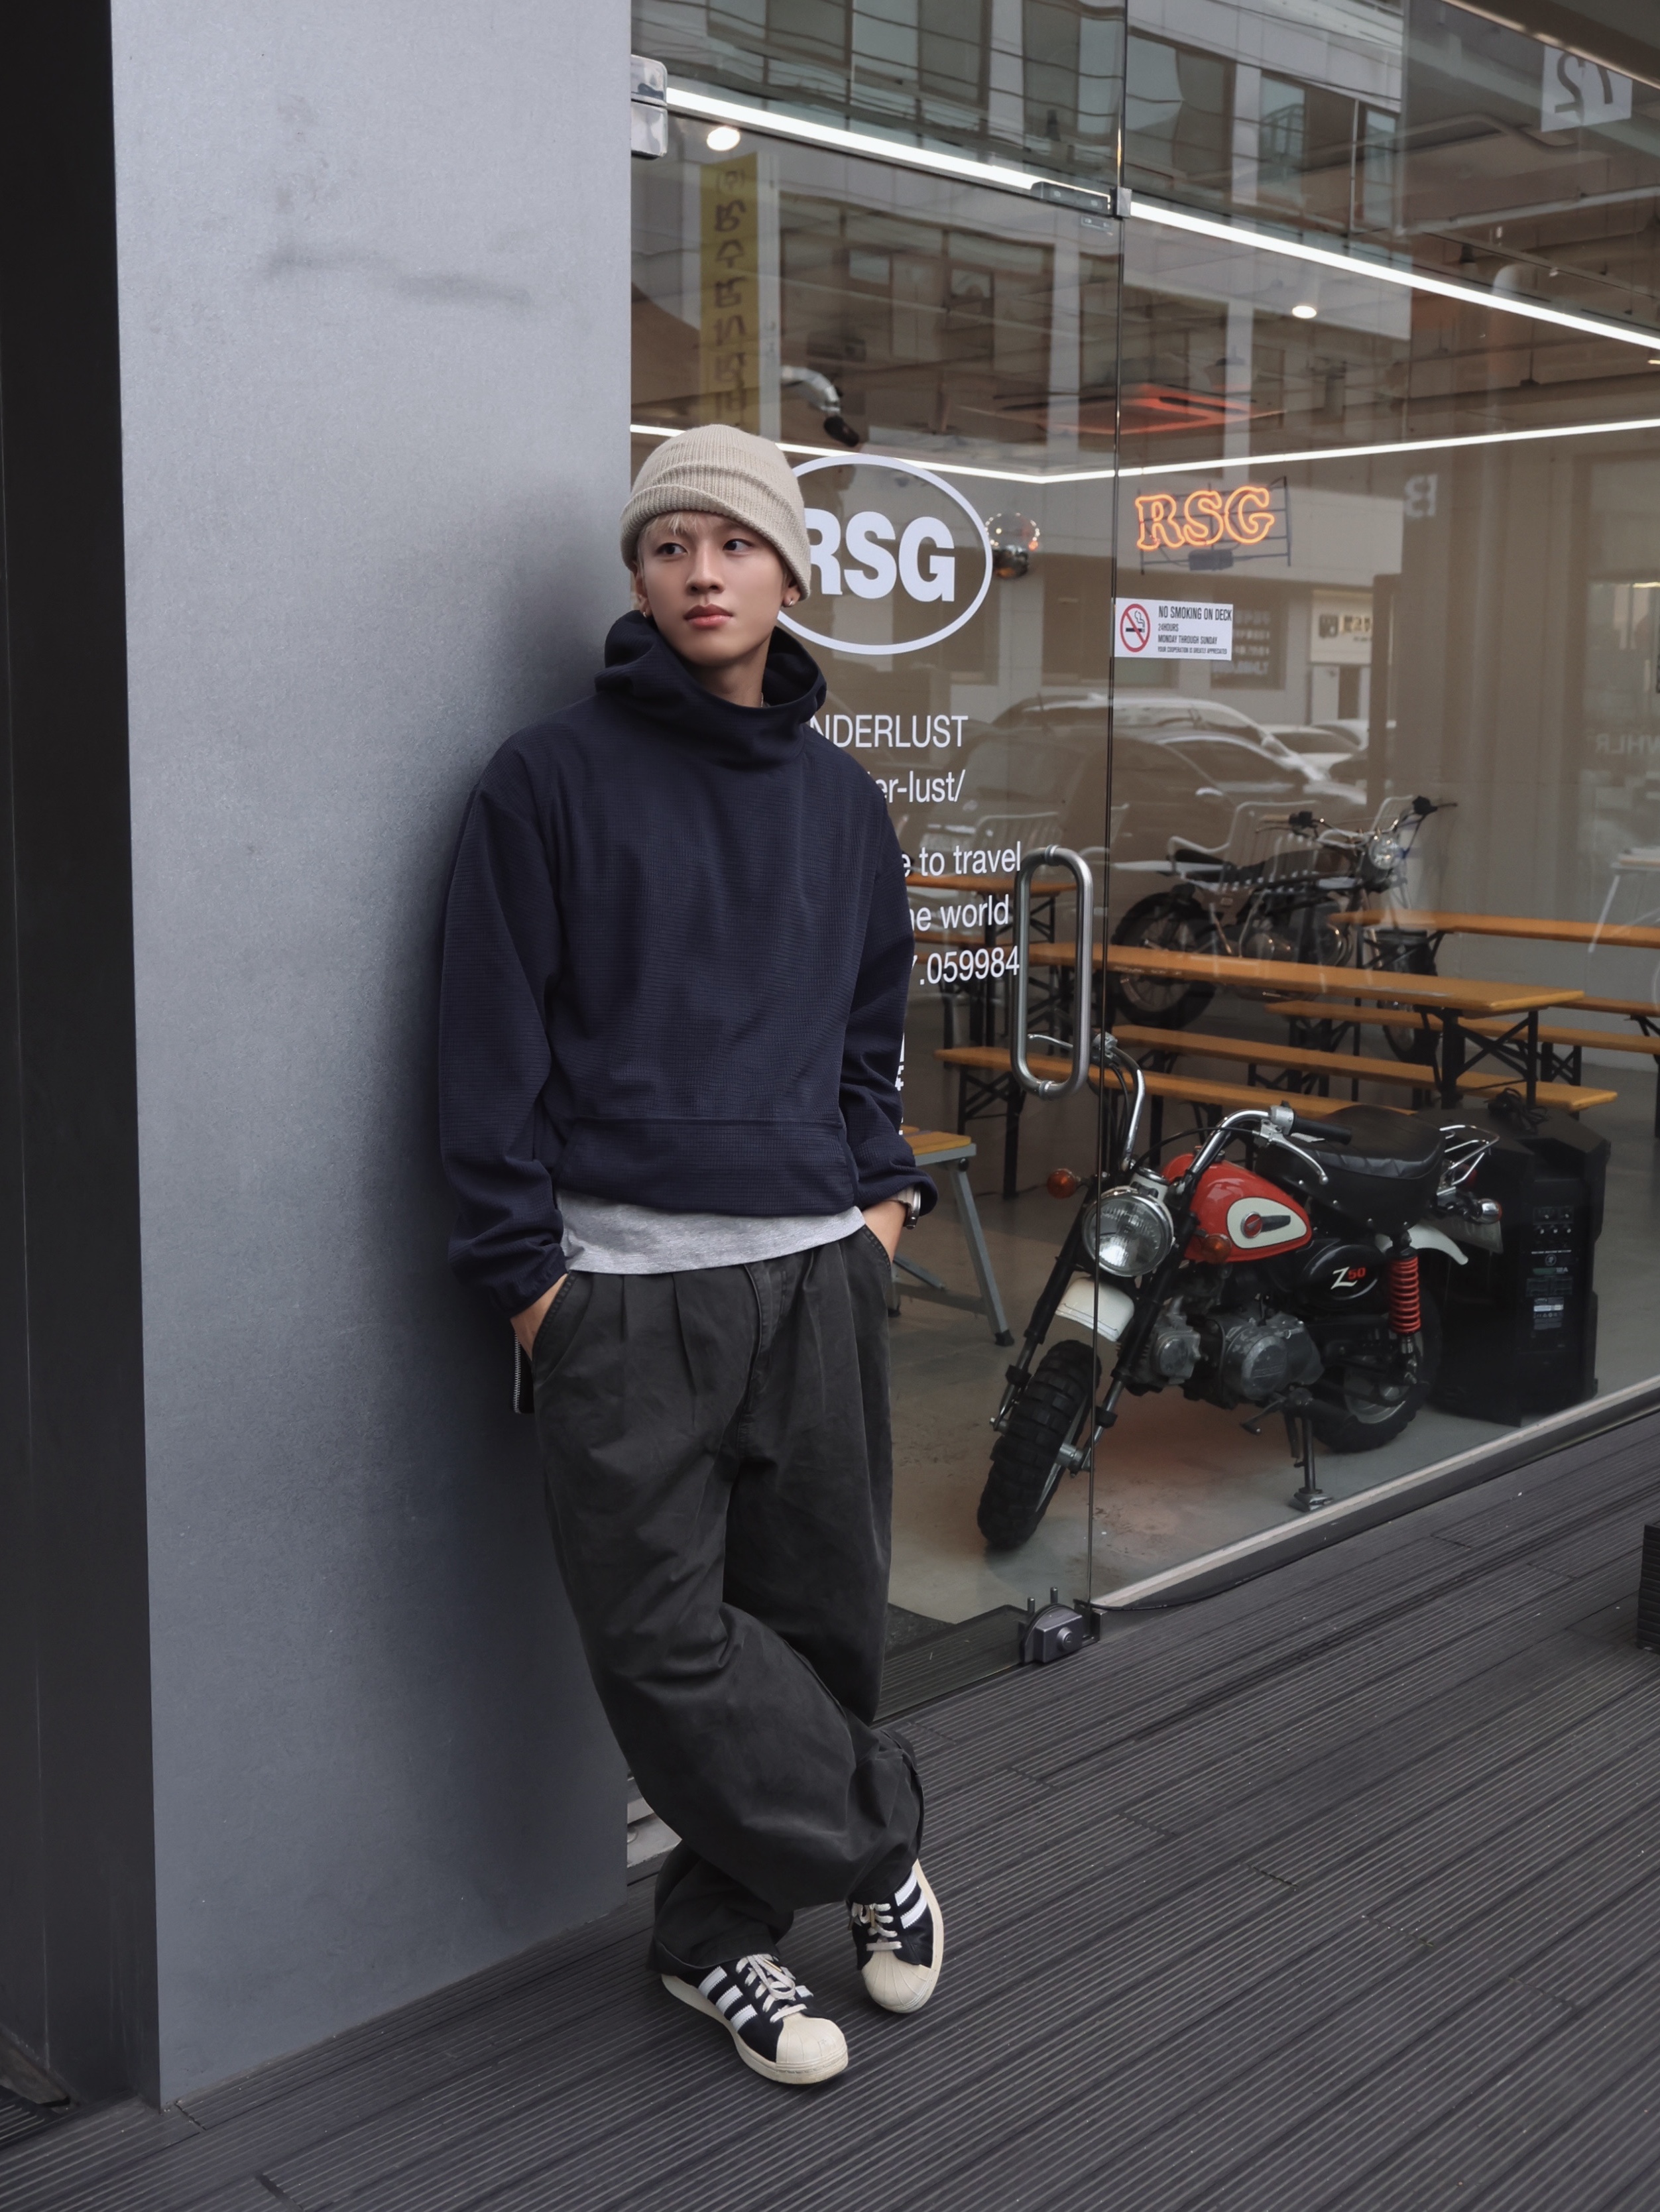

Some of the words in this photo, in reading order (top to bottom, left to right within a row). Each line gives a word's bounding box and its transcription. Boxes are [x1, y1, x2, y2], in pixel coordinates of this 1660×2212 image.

[1134, 485, 1275, 552] RSG
[804, 508, 955, 603] RSG
[1157, 623, 1179, 632] 24HOURS
[1158, 605, 1168, 618] NO
[1170, 606, 1202, 620] SMOKING
[1204, 608, 1213, 620] ON
[1215, 609, 1232, 621] DECK
[1157, 634, 1177, 643] MONDAY
[1178, 635, 1199, 644] THROUGH
[919, 846, 945, 877] to
[953, 841, 1021, 875] travel
[940, 894, 1009, 929] world
